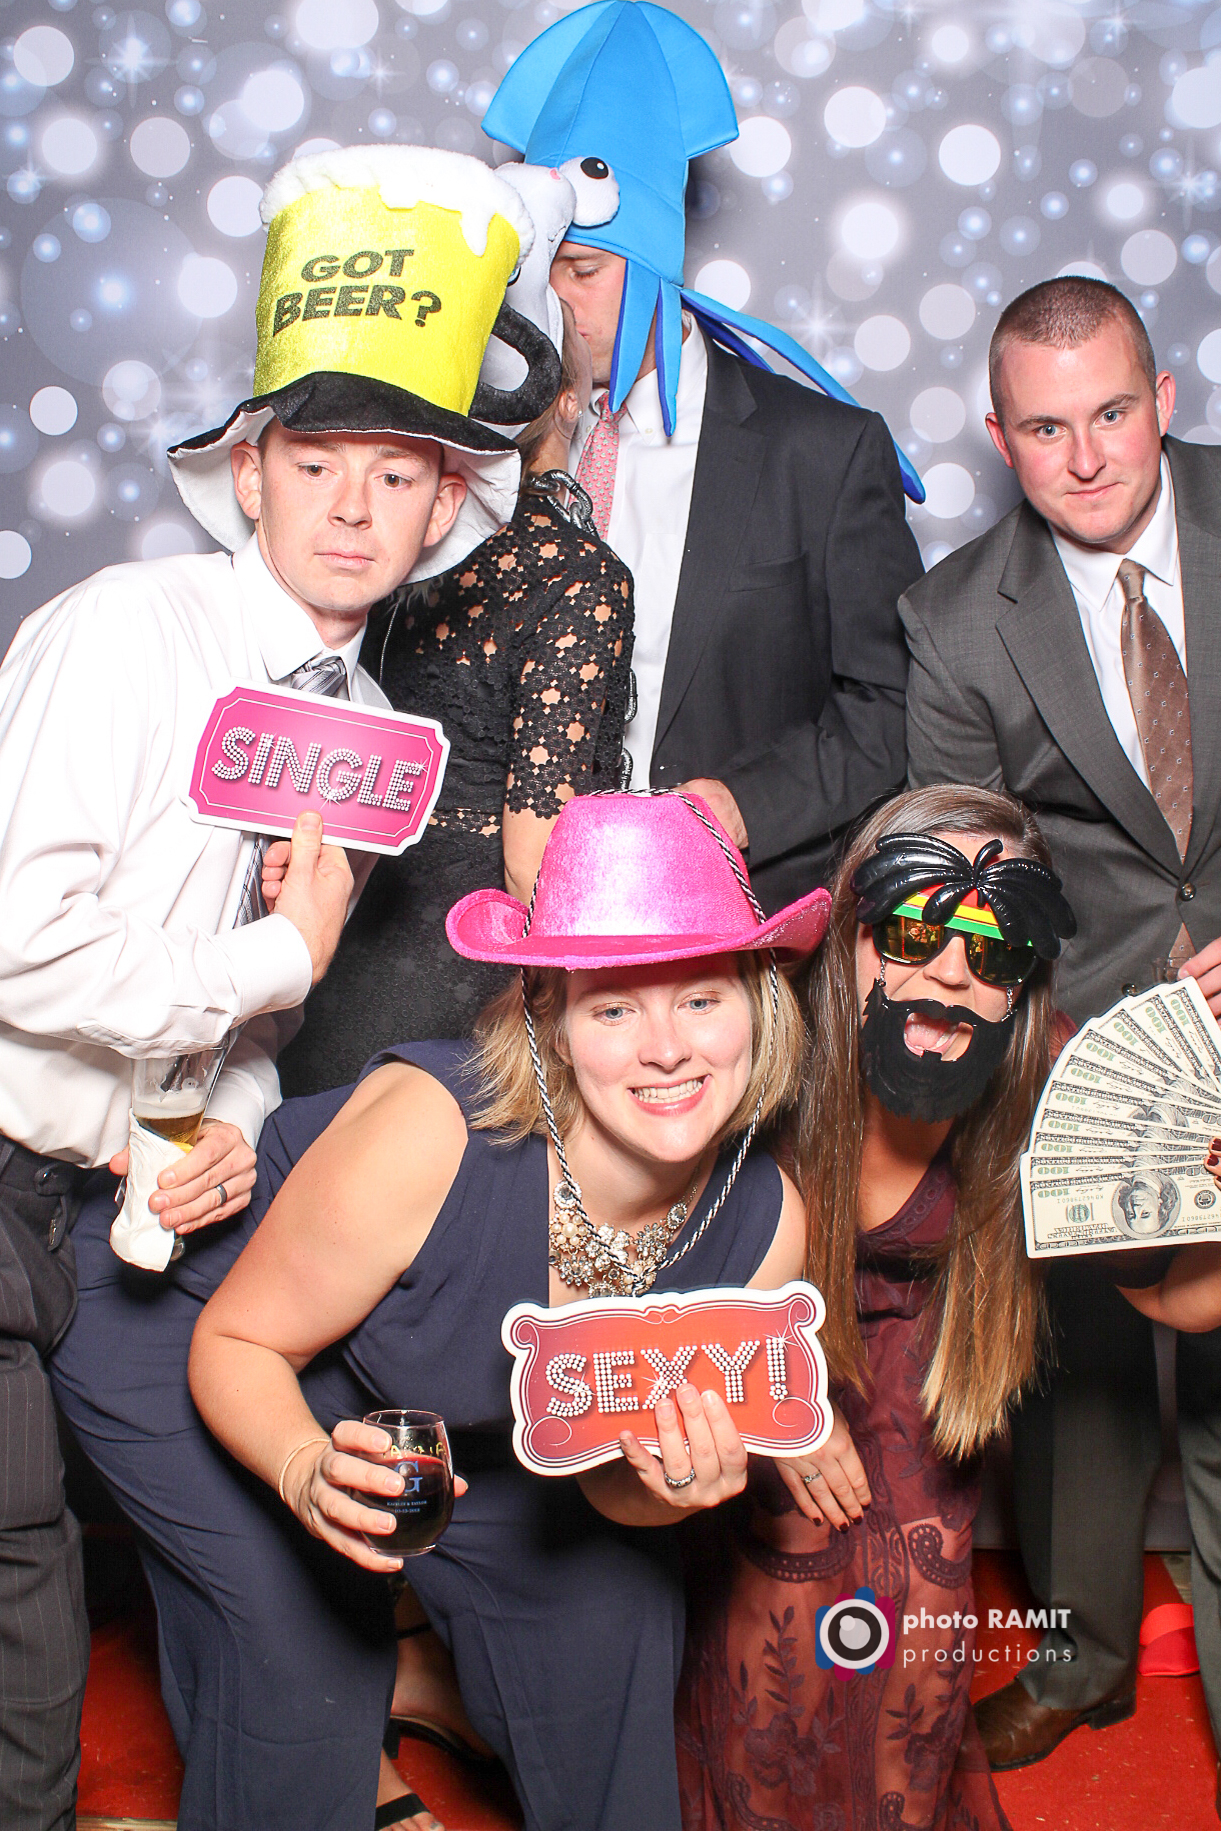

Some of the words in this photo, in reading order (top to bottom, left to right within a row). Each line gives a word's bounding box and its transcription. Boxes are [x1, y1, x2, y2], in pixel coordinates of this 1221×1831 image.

[301, 249, 415, 282] GOT
[273, 285, 442, 337] BEER?
[211, 726, 424, 812] SINGLE
[1146, 1006, 1166, 1034] 100
[1170, 998, 1190, 1026] 100
[1114, 1022, 1138, 1046] 100
[1086, 1042, 1116, 1062] 100
[1072, 1068, 1102, 1084] 100
[1056, 1092, 1086, 1106] 100
[1048, 1120, 1080, 1132] 100
[1042, 1144, 1072, 1154] 100
[1038, 1166, 1070, 1174] 100
[1038, 1188, 1070, 1198] 100
[546, 1337, 788, 1418] SEXY!
